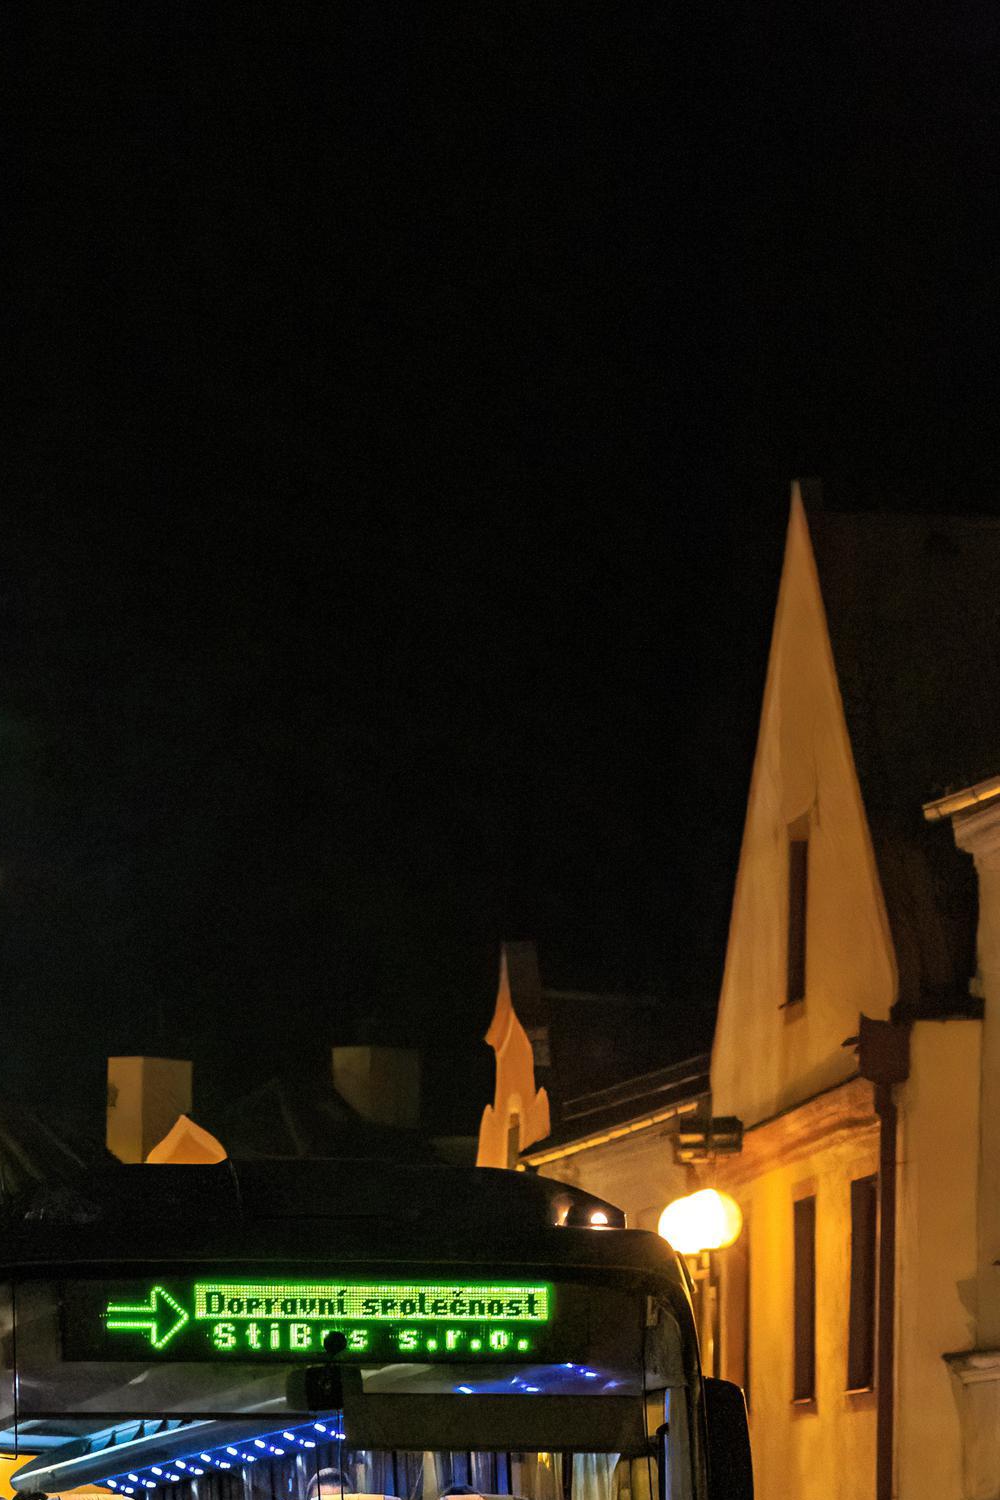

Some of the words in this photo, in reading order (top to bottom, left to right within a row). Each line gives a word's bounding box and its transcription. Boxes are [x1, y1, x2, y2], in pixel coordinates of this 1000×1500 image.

[206, 1289, 348, 1315] Dopravní
[361, 1291, 539, 1316] společnost
[213, 1322, 369, 1350] StiBs
[398, 1330, 529, 1351] s.r.o.
